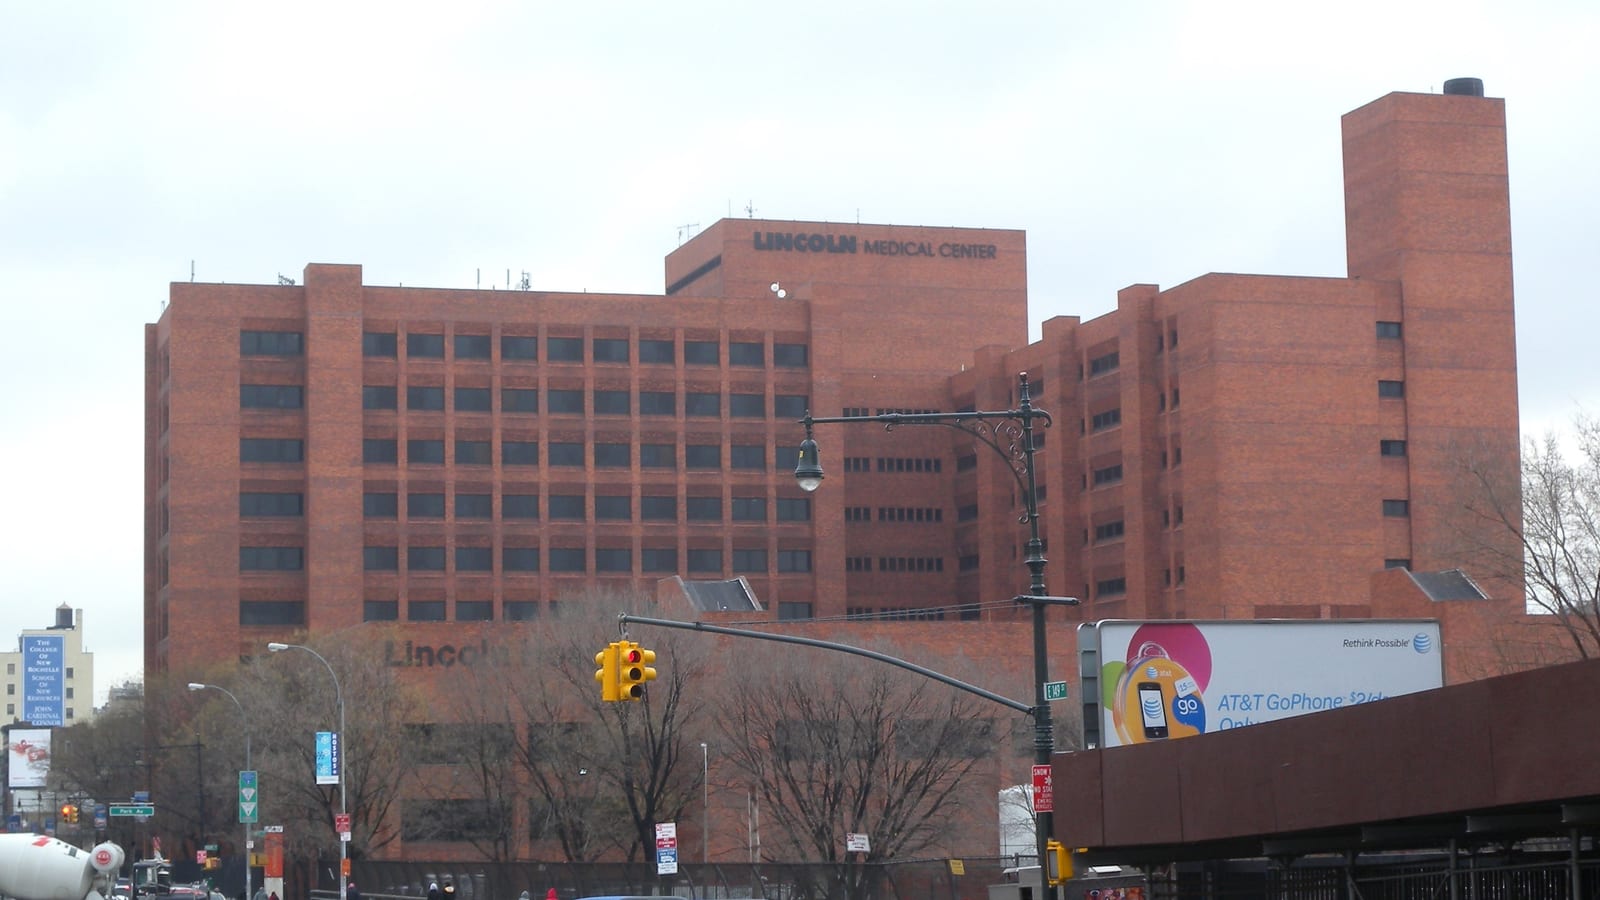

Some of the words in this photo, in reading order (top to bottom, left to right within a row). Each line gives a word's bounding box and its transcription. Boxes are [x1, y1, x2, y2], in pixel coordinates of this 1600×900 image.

[754, 232, 857, 254] LINCOLN
[864, 240, 935, 257] MEDICAL
[938, 243, 997, 259] CENTER
[1343, 639, 1374, 648] Rethink
[1375, 639, 1409, 648] Possible
[1052, 684, 1061, 697] 149
[1178, 699, 1198, 715] go
[1218, 694, 1264, 711] AT&T
[1267, 693, 1343, 710] GoPhone
[1034, 768, 1047, 776] SNOW
